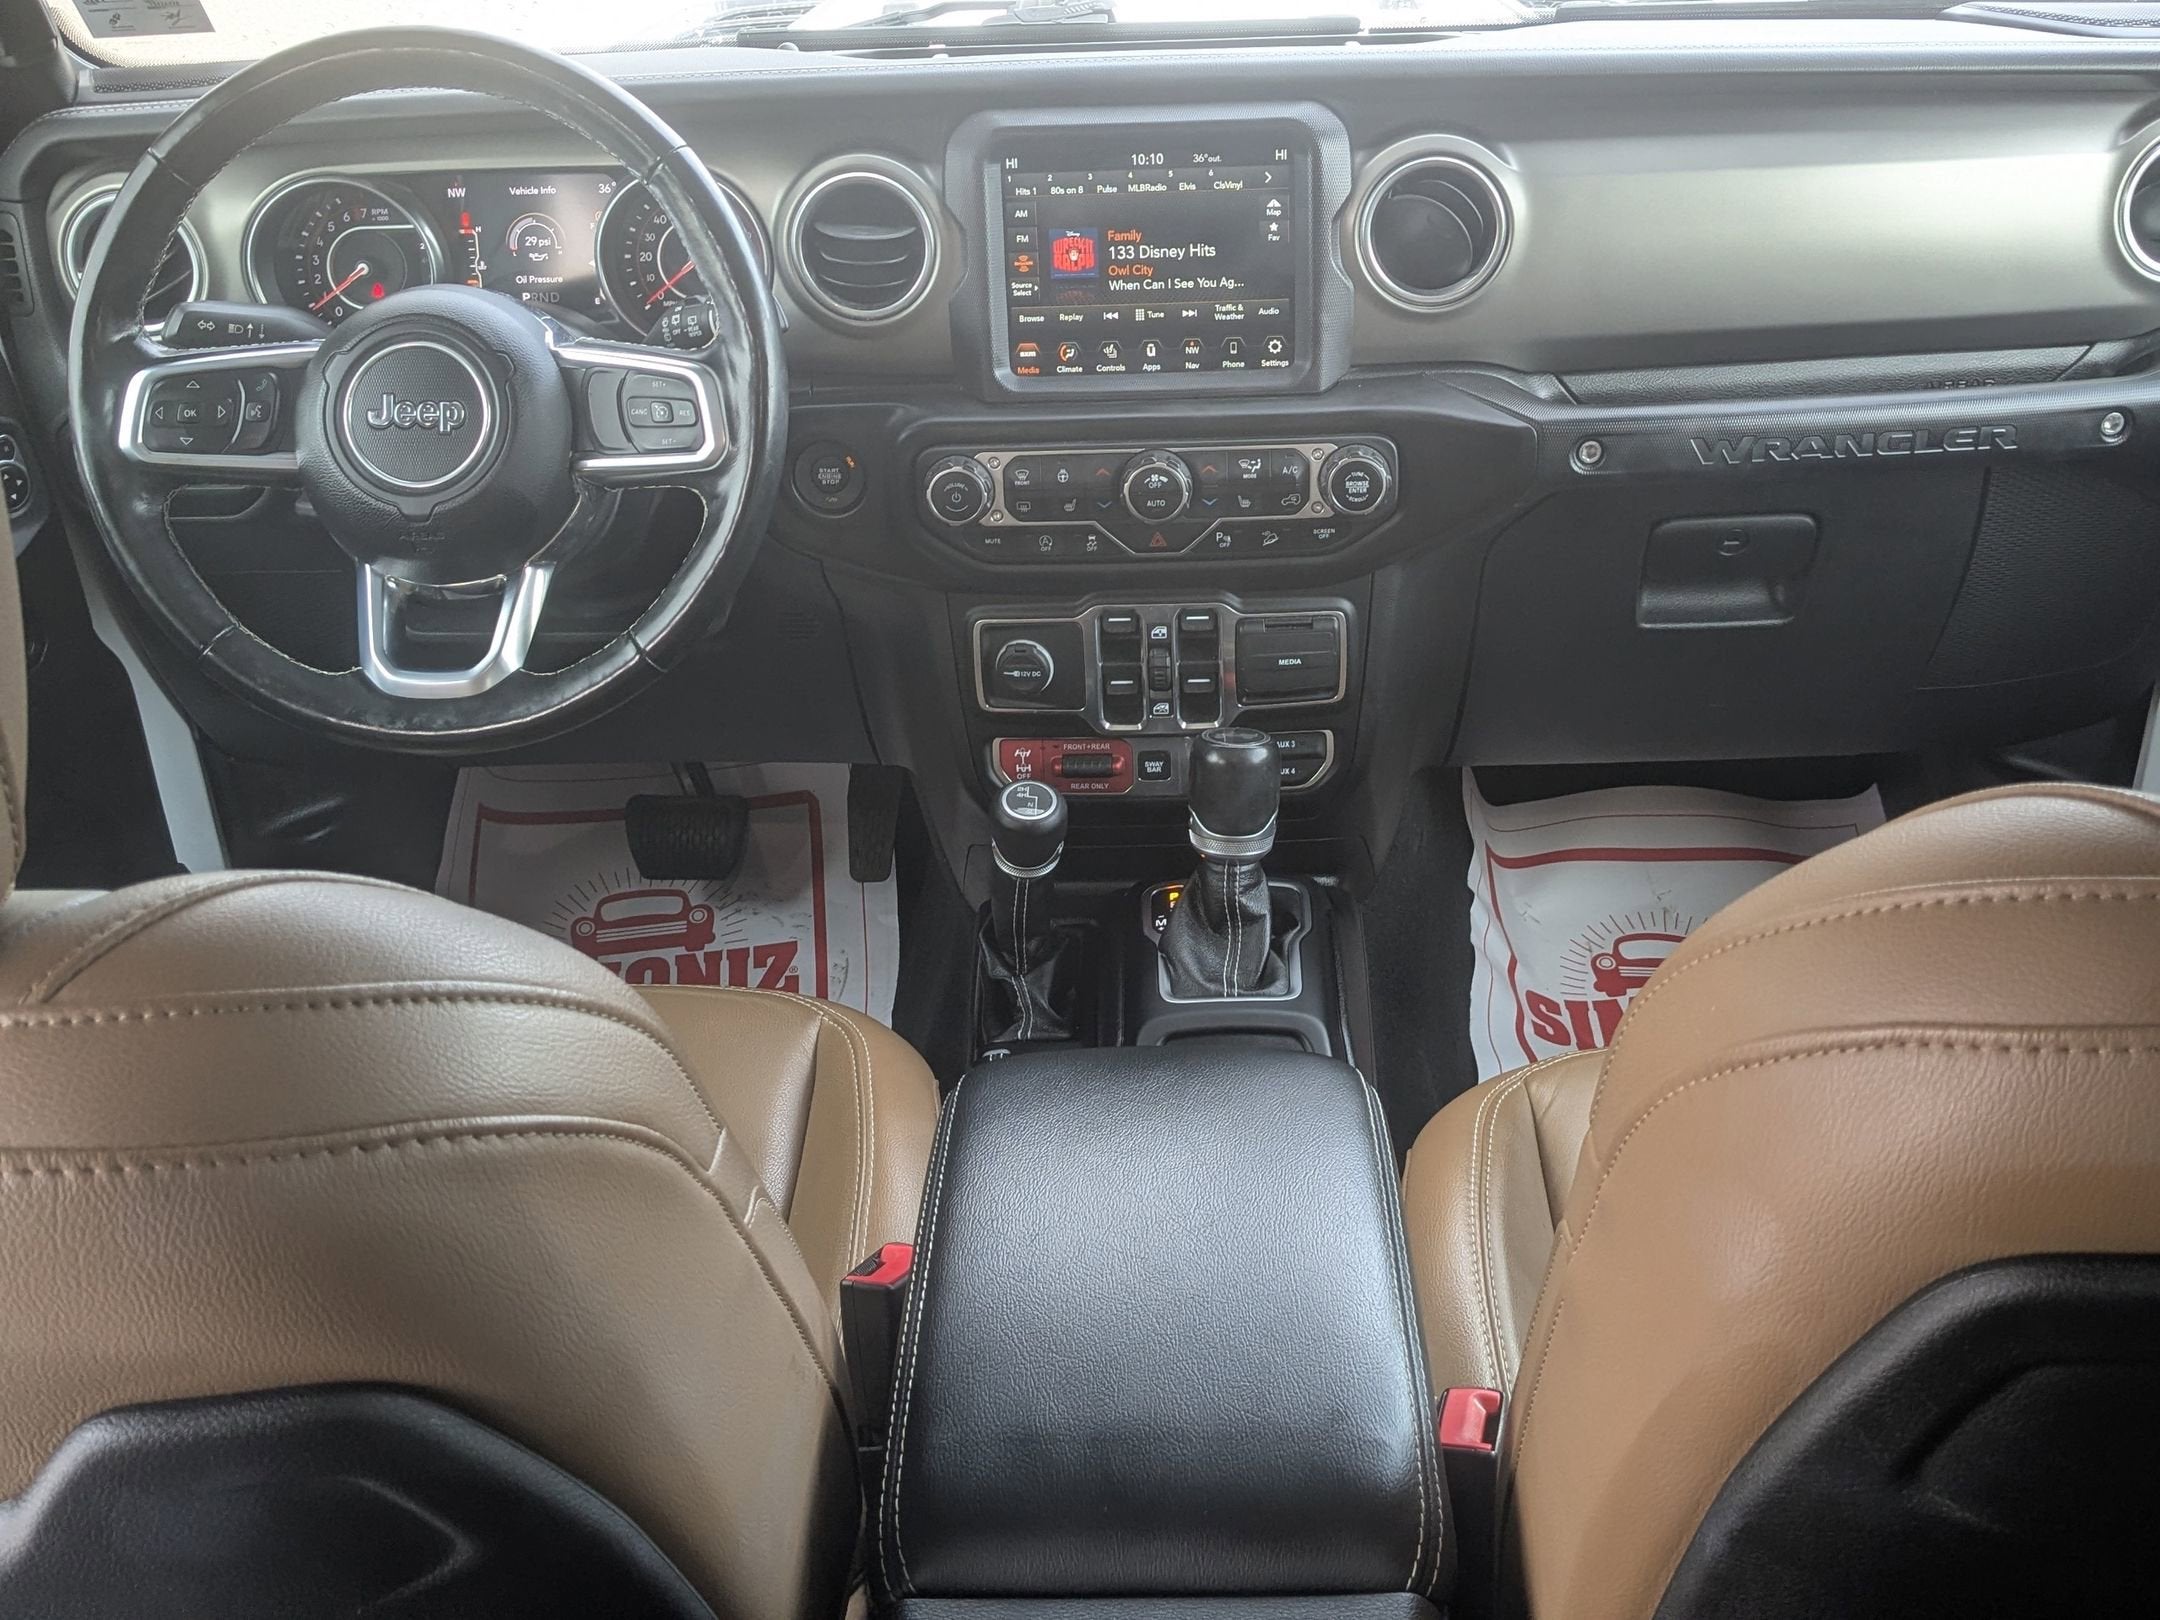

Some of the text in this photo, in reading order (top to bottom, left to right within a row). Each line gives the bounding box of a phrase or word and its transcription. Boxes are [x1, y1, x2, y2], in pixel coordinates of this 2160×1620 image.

[1131, 153, 1164, 166] 10:10
[1275, 149, 1288, 161] HI
[1006, 158, 1018, 169] HI
[1128, 171, 1133, 179] 4
[1208, 169, 1214, 177] 6
[1048, 174, 1053, 182] 2
[447, 187, 466, 198] NW
[509, 185, 557, 195] Vehicle Info
[1015, 187, 1031, 196] Hits
[1050, 185, 1084, 195] 80s on 8
[1097, 184, 1118, 194] Pulse
[1127, 183, 1167, 193] MLBRadio
[343, 211, 351, 222] 6
[360, 208, 367, 219] 7
[1014, 209, 1028, 218] AM
[1266, 208, 1282, 217] Map
[653, 214, 667, 225] 40
[327, 221, 335, 232] 5
[644, 232, 656, 242] 30
[1016, 234, 1029, 243] FM
[1107, 229, 1142, 243] Family
[317, 237, 324, 247] 4
[524, 236, 551, 247] 29 psi
[1108, 243, 1216, 260] 133 Disney Hits
[312, 255, 320, 265] 3
[640, 251, 653, 262] 20
[1108, 264, 1130, 276] Owl
[1132, 264, 1154, 277] City
[314, 273, 322, 284] 2
[515, 275, 563, 284] Oil Pressure
[646, 273, 655, 282] 10
[1108, 280, 1140, 291] When
[1143, 279, 1165, 290] Can
[1174, 278, 1195, 289] See
[1196, 277, 1217, 288] You
[335, 306, 343, 317] 0
[1214, 304, 1236, 312] Traffic
[1258, 307, 1280, 316] Audio
[1018, 315, 1045, 323] Browse
[1059, 313, 1084, 323] Replay
[1147, 310, 1165, 319] Tune
[1214, 312, 1245, 321] Weather
[1185, 346, 1200, 355] NW
[1096, 363, 1126, 372] Controls
[1142, 363, 1161, 372] Apps
[1185, 361, 1200, 370] Nav
[1222, 360, 1245, 369] Phone
[1261, 359, 1289, 368] Settings
[1017, 366, 1040, 375] Media
[1056, 365, 1083, 374] Climate
[183, 408, 197, 418] OK
[366, 393, 466, 434] Jeep
[1690, 422, 2019, 466] WRANGLER
[1282, 465, 1299, 475] A/C
[1148, 481, 1163, 489] OFF
[1345, 480, 1370, 488] BROWSE
[1146, 499, 1166, 508] AUTO
[1278, 658, 1302, 666] MEDIA
[1020, 670, 1042, 678] 12V DC
[1290, 739, 1296, 748] 3
[1016, 772, 1031, 780] OFF
[1091, 782, 1110, 790] ONLY
[1169, 892, 1180, 901] P
[1155, 918, 1167, 927] M
[600, 940, 800, 994] ONIZ
